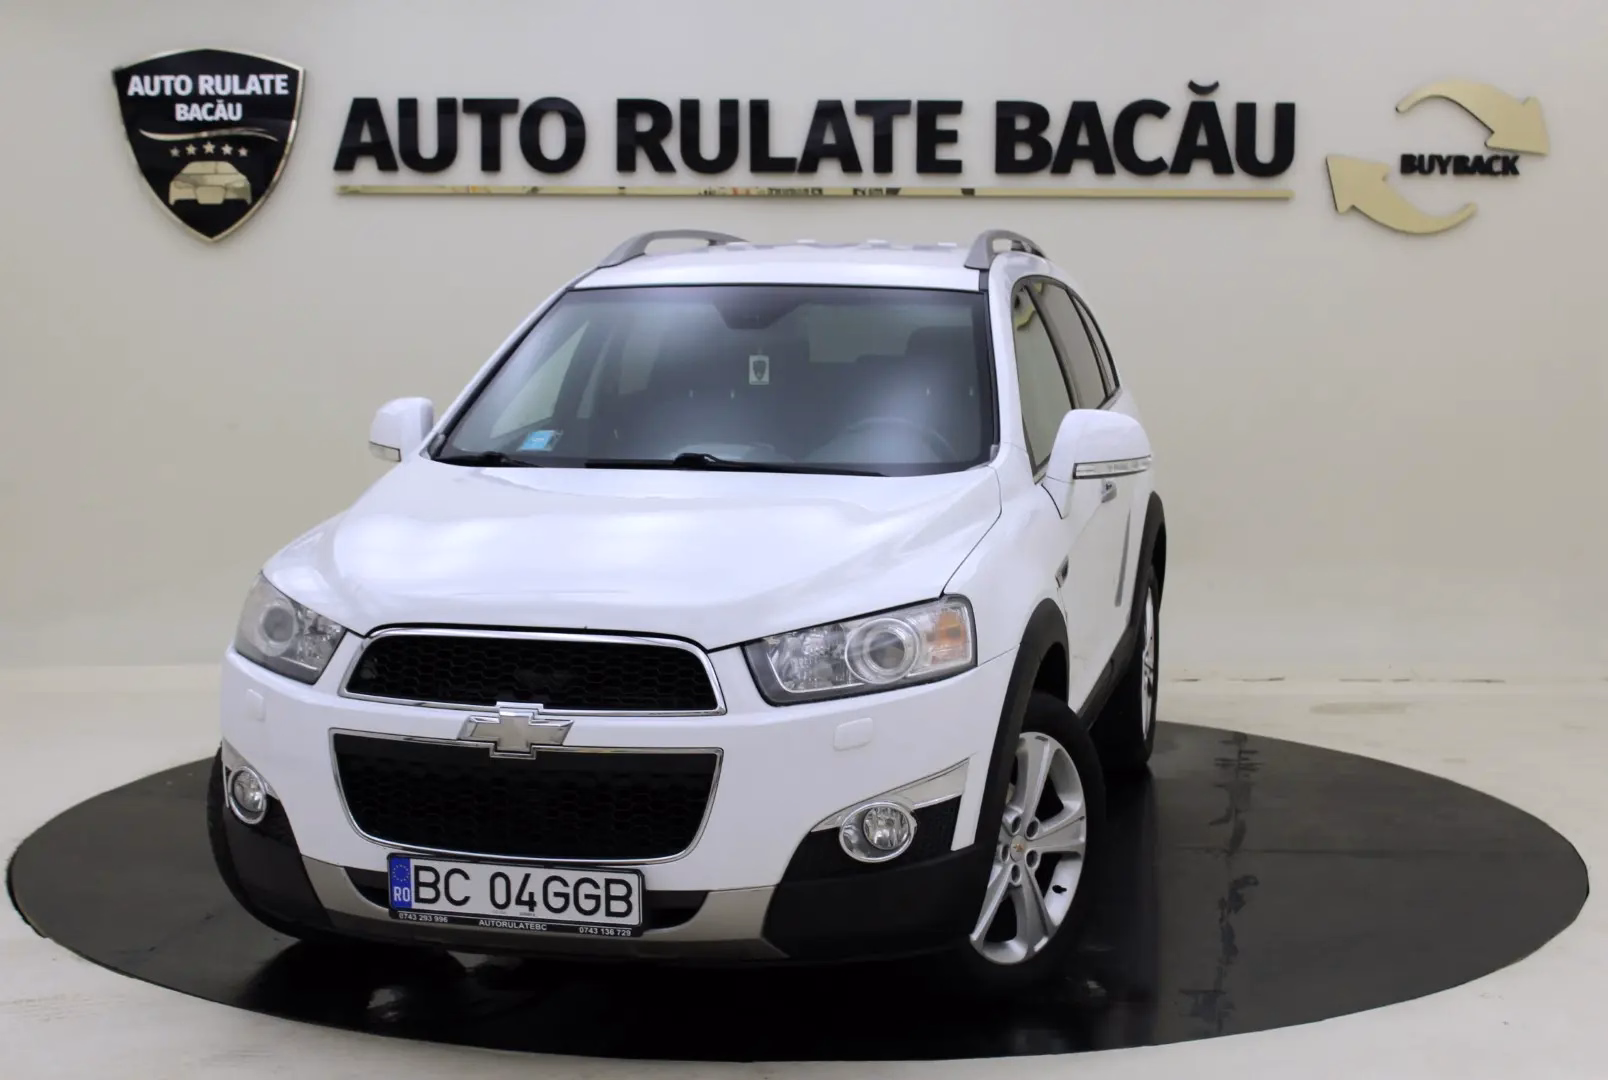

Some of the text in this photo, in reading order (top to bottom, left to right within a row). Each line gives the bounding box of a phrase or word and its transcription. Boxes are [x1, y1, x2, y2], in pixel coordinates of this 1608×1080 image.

[127, 74, 289, 96] AUTO RULATE
[174, 99, 243, 121] BACĂU
[333, 79, 1296, 178] AUTO RULATE BACĂU
[1400, 154, 1520, 176] BUYBACK
[393, 886, 410, 902] RO
[414, 865, 471, 906] BC
[398, 912, 417, 921] 0743
[479, 919, 547, 931] AUTORULATEBC
[579, 926, 598, 935] 0743
[617, 929, 631, 937] 729
